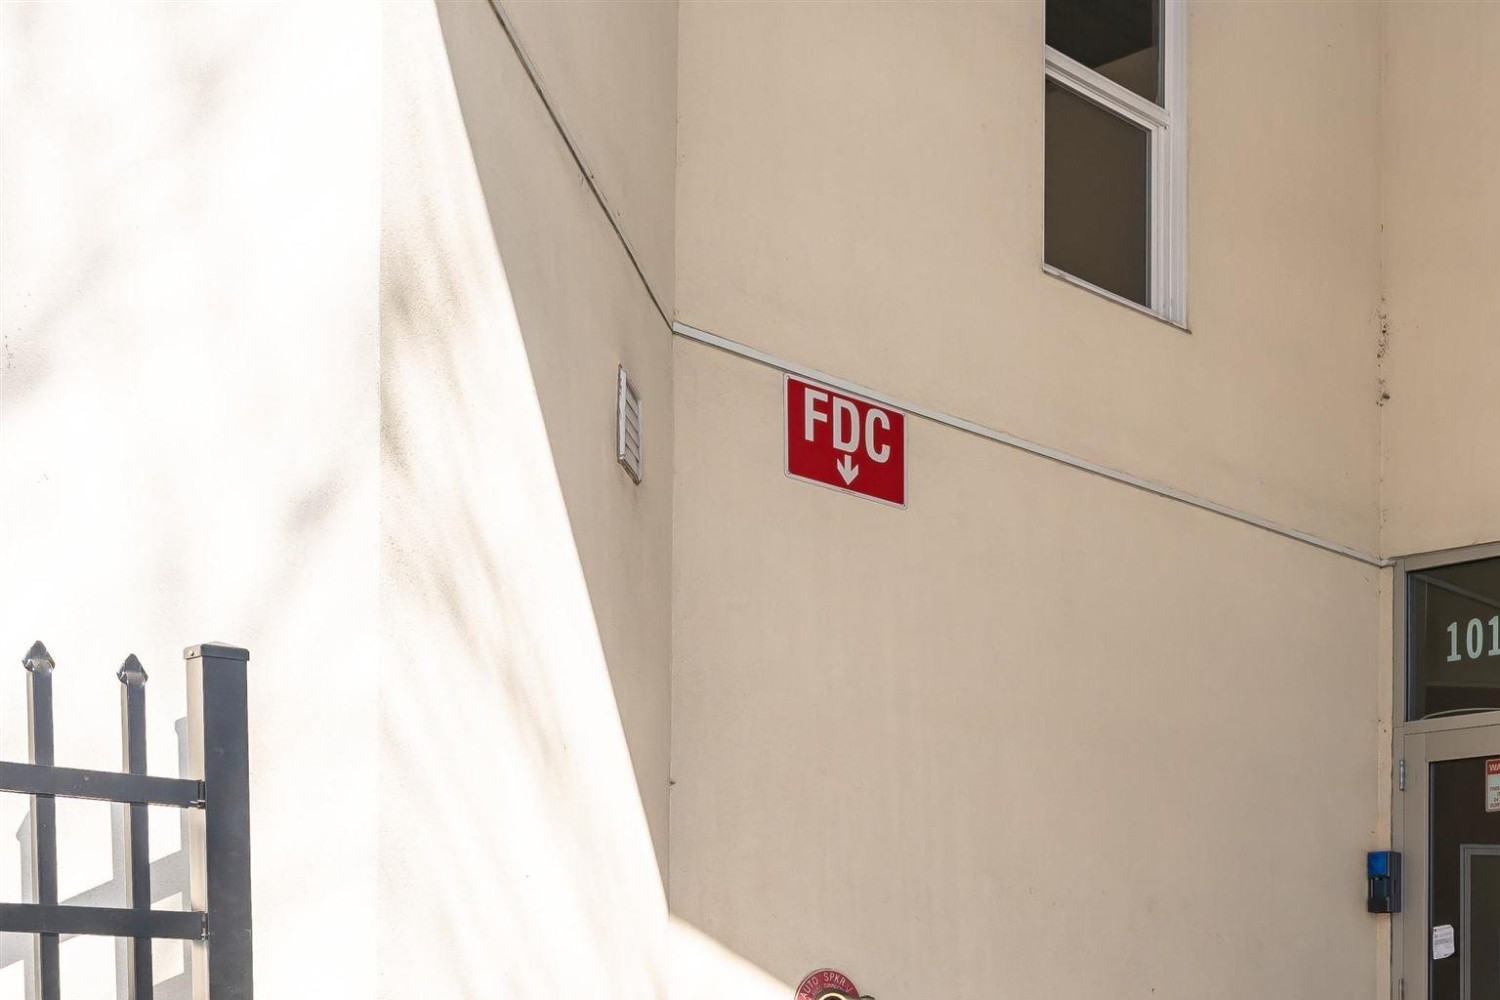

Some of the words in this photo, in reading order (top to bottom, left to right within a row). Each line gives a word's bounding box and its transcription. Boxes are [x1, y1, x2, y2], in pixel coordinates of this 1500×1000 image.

[804, 387, 891, 464] FDC
[800, 976, 819, 1000] AUTO
[823, 972, 845, 986] SPKR
